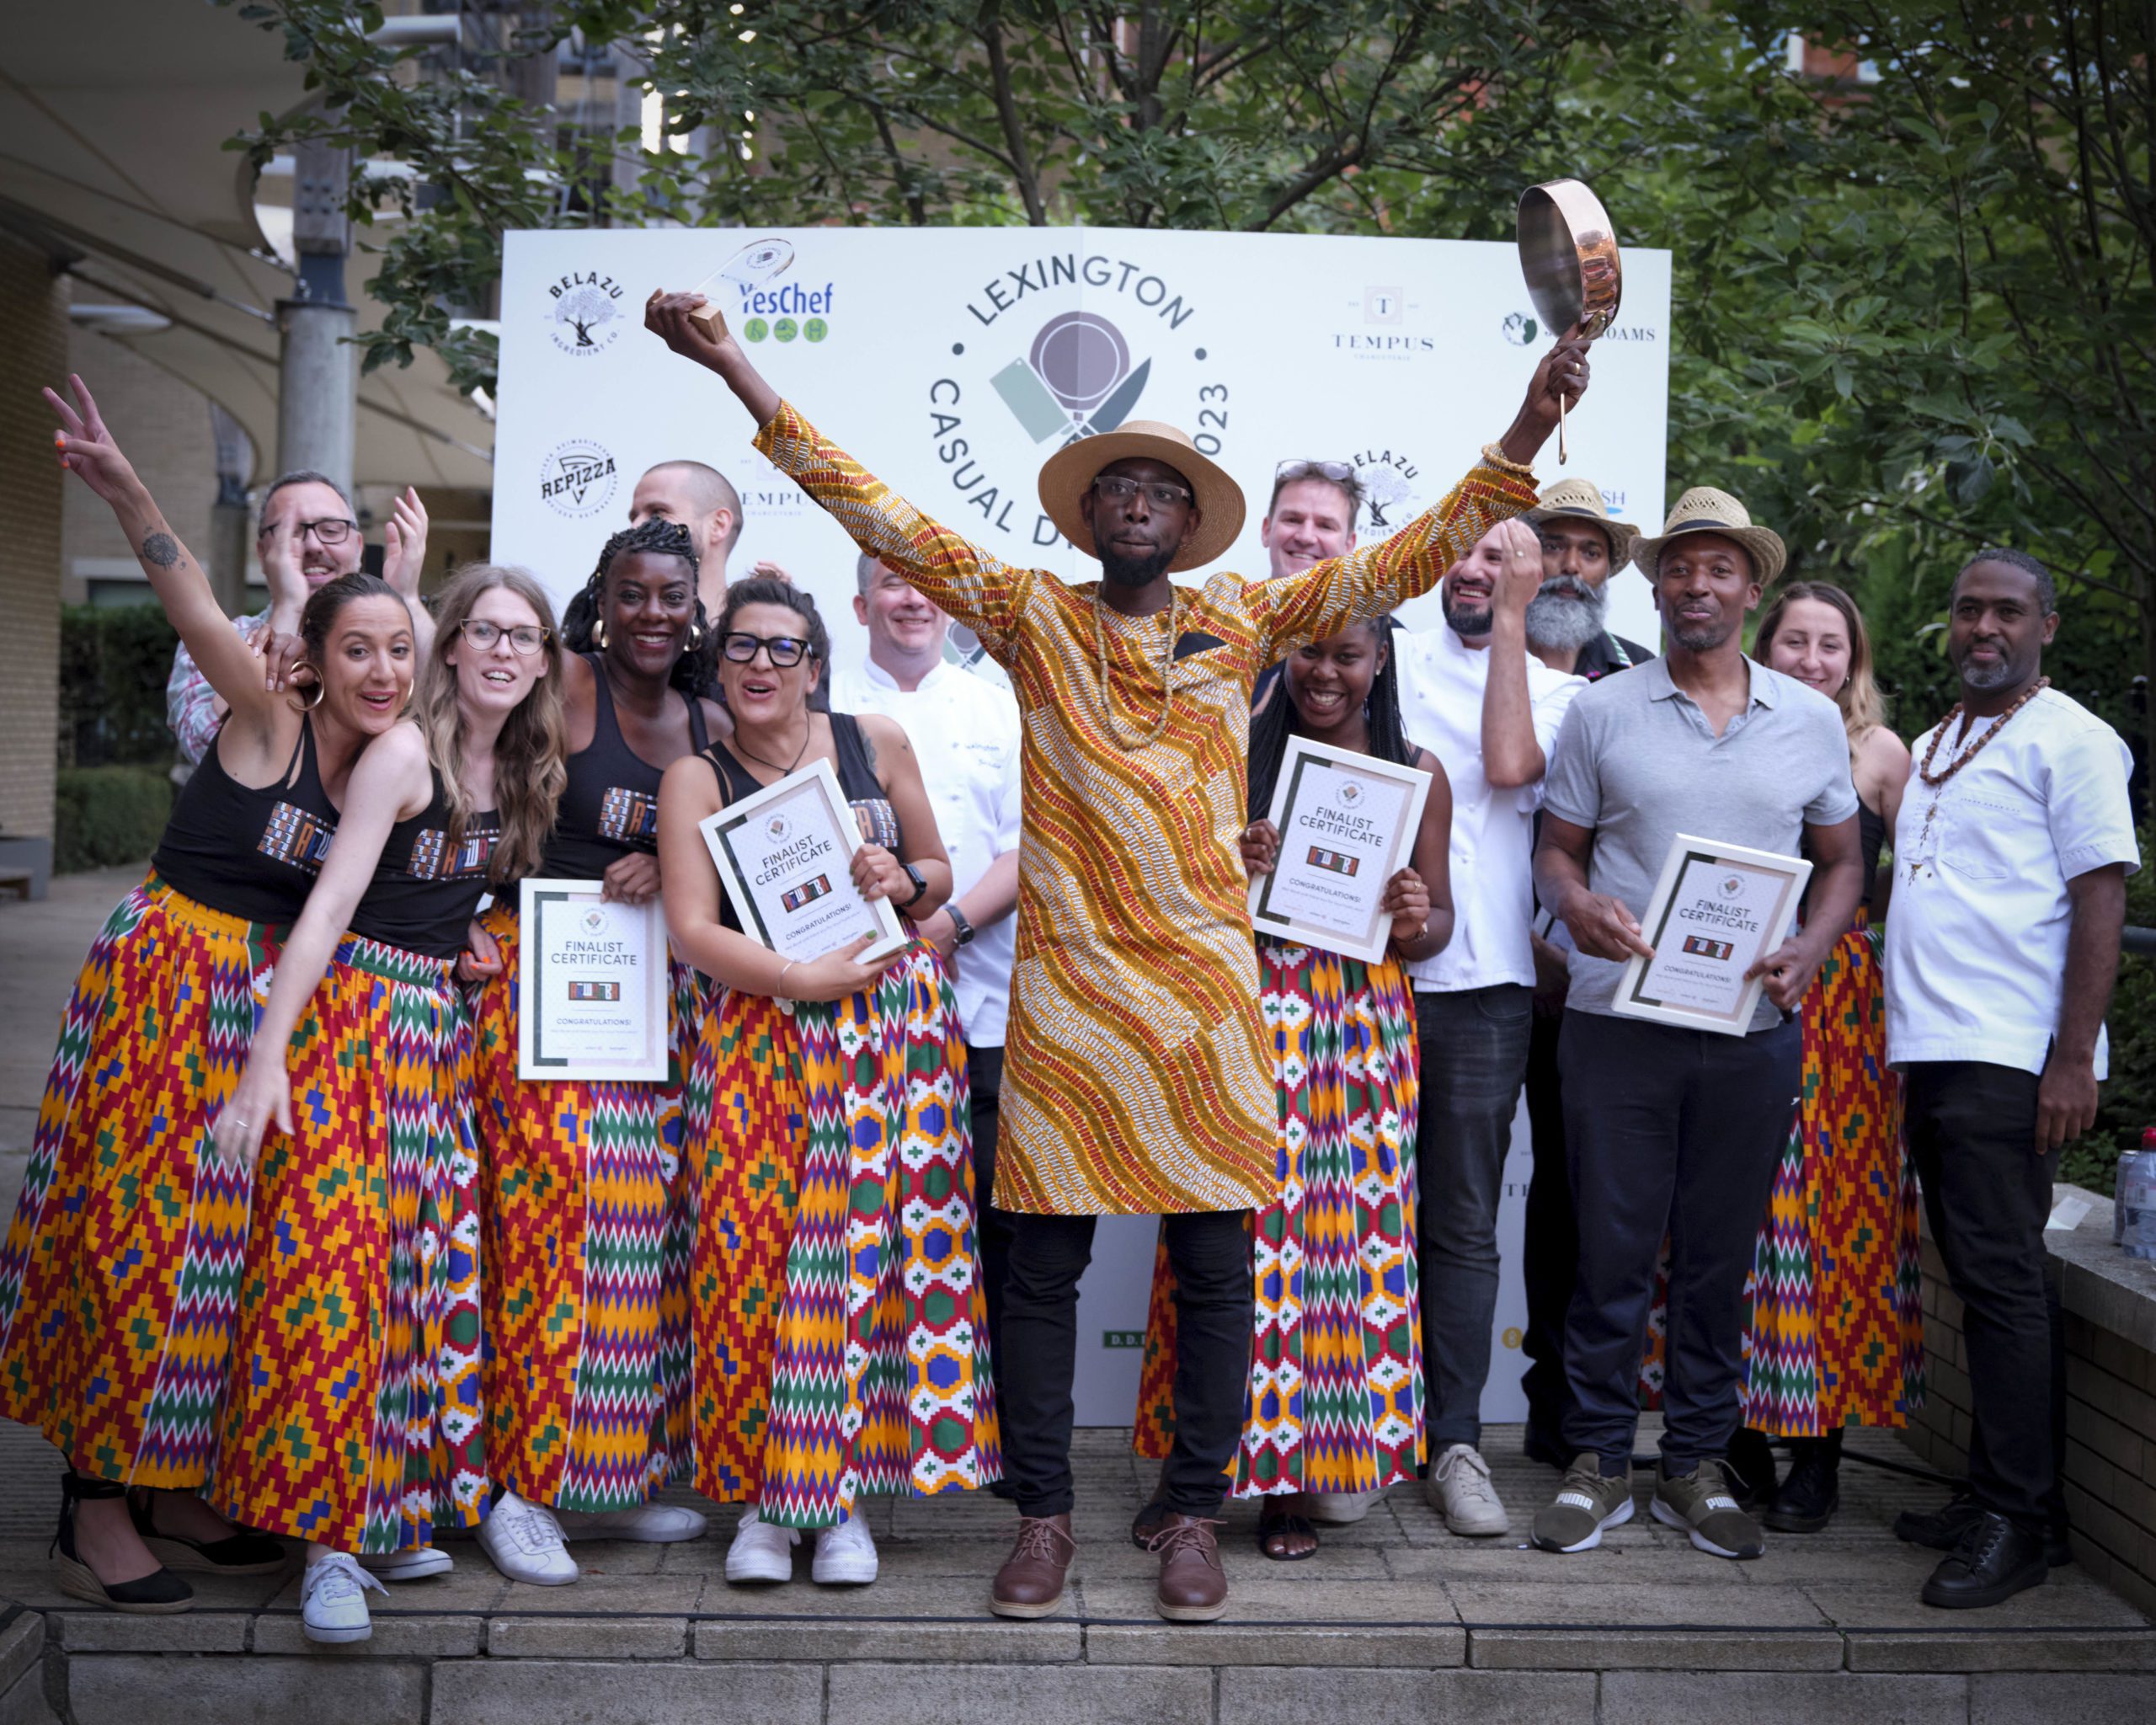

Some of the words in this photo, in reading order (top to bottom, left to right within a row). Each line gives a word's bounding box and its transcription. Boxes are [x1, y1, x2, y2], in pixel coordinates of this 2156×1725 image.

[548, 271, 623, 300] BELAZU
[739, 282, 833, 314] YesChef
[966, 254, 1194, 331] LEXINGTON
[1331, 334, 1434, 351] TEMPUS
[929, 377, 1015, 533] CASUAL
[1193, 383, 1229, 456] 023
[1348, 449, 1419, 479] ELAZU
[542, 457, 616, 499] REPIZZA
[741, 493, 810, 506] EMPU
[1601, 490, 1625, 505] SH
[1299, 814, 1384, 847] CERTIFICATE
[1315, 806, 1374, 831] FINALIST
[755, 840, 833, 886] CERTIFICATE
[762, 834, 814, 868] FINALIST
[1289, 878, 1362, 904] CONGRATULATIONS!
[785, 903, 852, 941] CONGRATULATIONS!
[1679, 908, 1759, 932] CERTIFICATE
[1695, 899, 1751, 919] FINALIST
[551, 953, 638, 965] CERTIFICATE
[565, 941, 623, 953] FINALIST
[556, 1017, 632, 1026] CONGRATULATIONS!
[1556, 1493, 1594, 1510] PUMA
